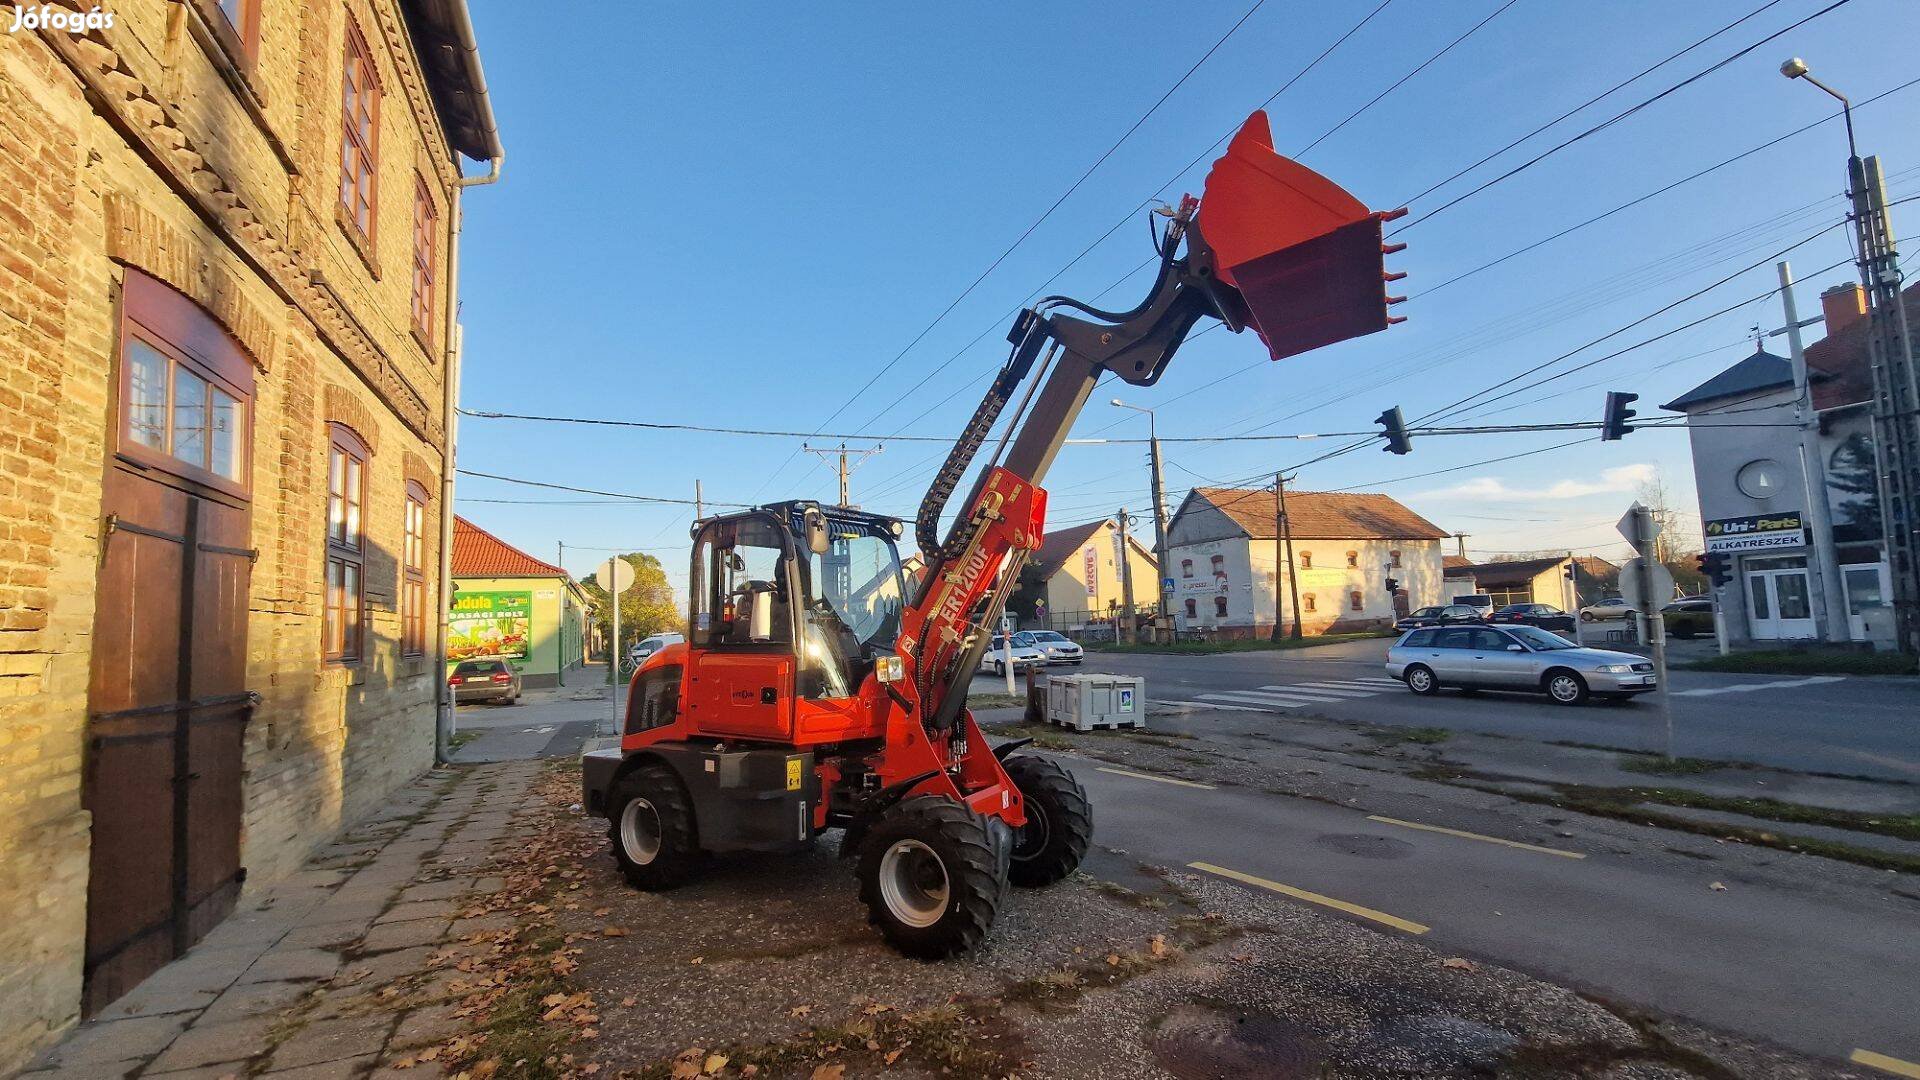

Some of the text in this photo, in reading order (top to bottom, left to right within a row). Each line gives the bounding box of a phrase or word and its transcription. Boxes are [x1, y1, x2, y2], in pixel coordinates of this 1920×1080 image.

[1723, 518, 1799, 533] Uni-Parts
[940, 544, 989, 622] ER1200F
[449, 611, 493, 619] DASÁGI
